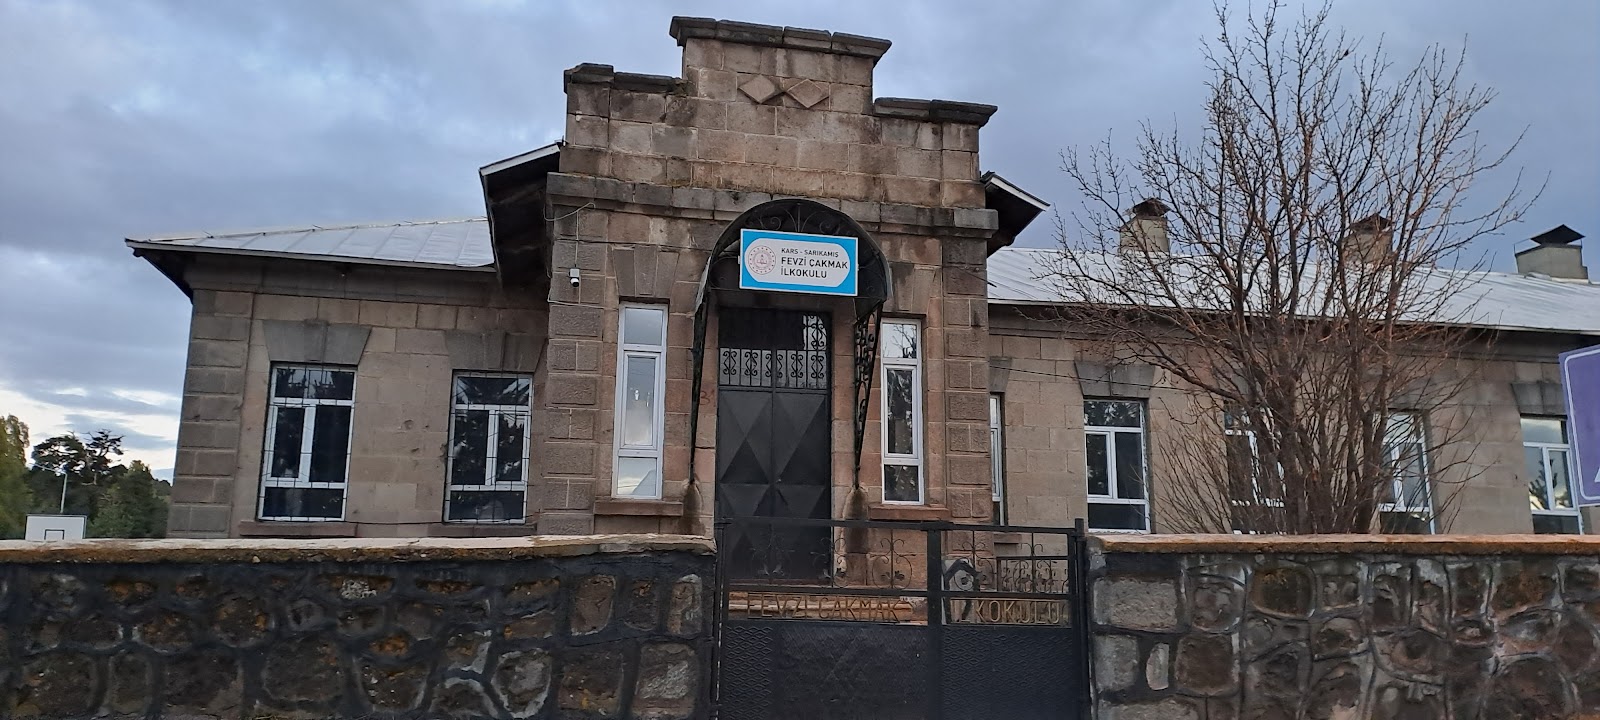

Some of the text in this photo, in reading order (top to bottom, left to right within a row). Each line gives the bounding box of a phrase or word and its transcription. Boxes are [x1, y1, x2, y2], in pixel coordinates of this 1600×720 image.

[781, 247, 798, 255] KARS
[781, 256, 807, 266] FEVZİ
[780, 266, 827, 278] İLKOKULU
